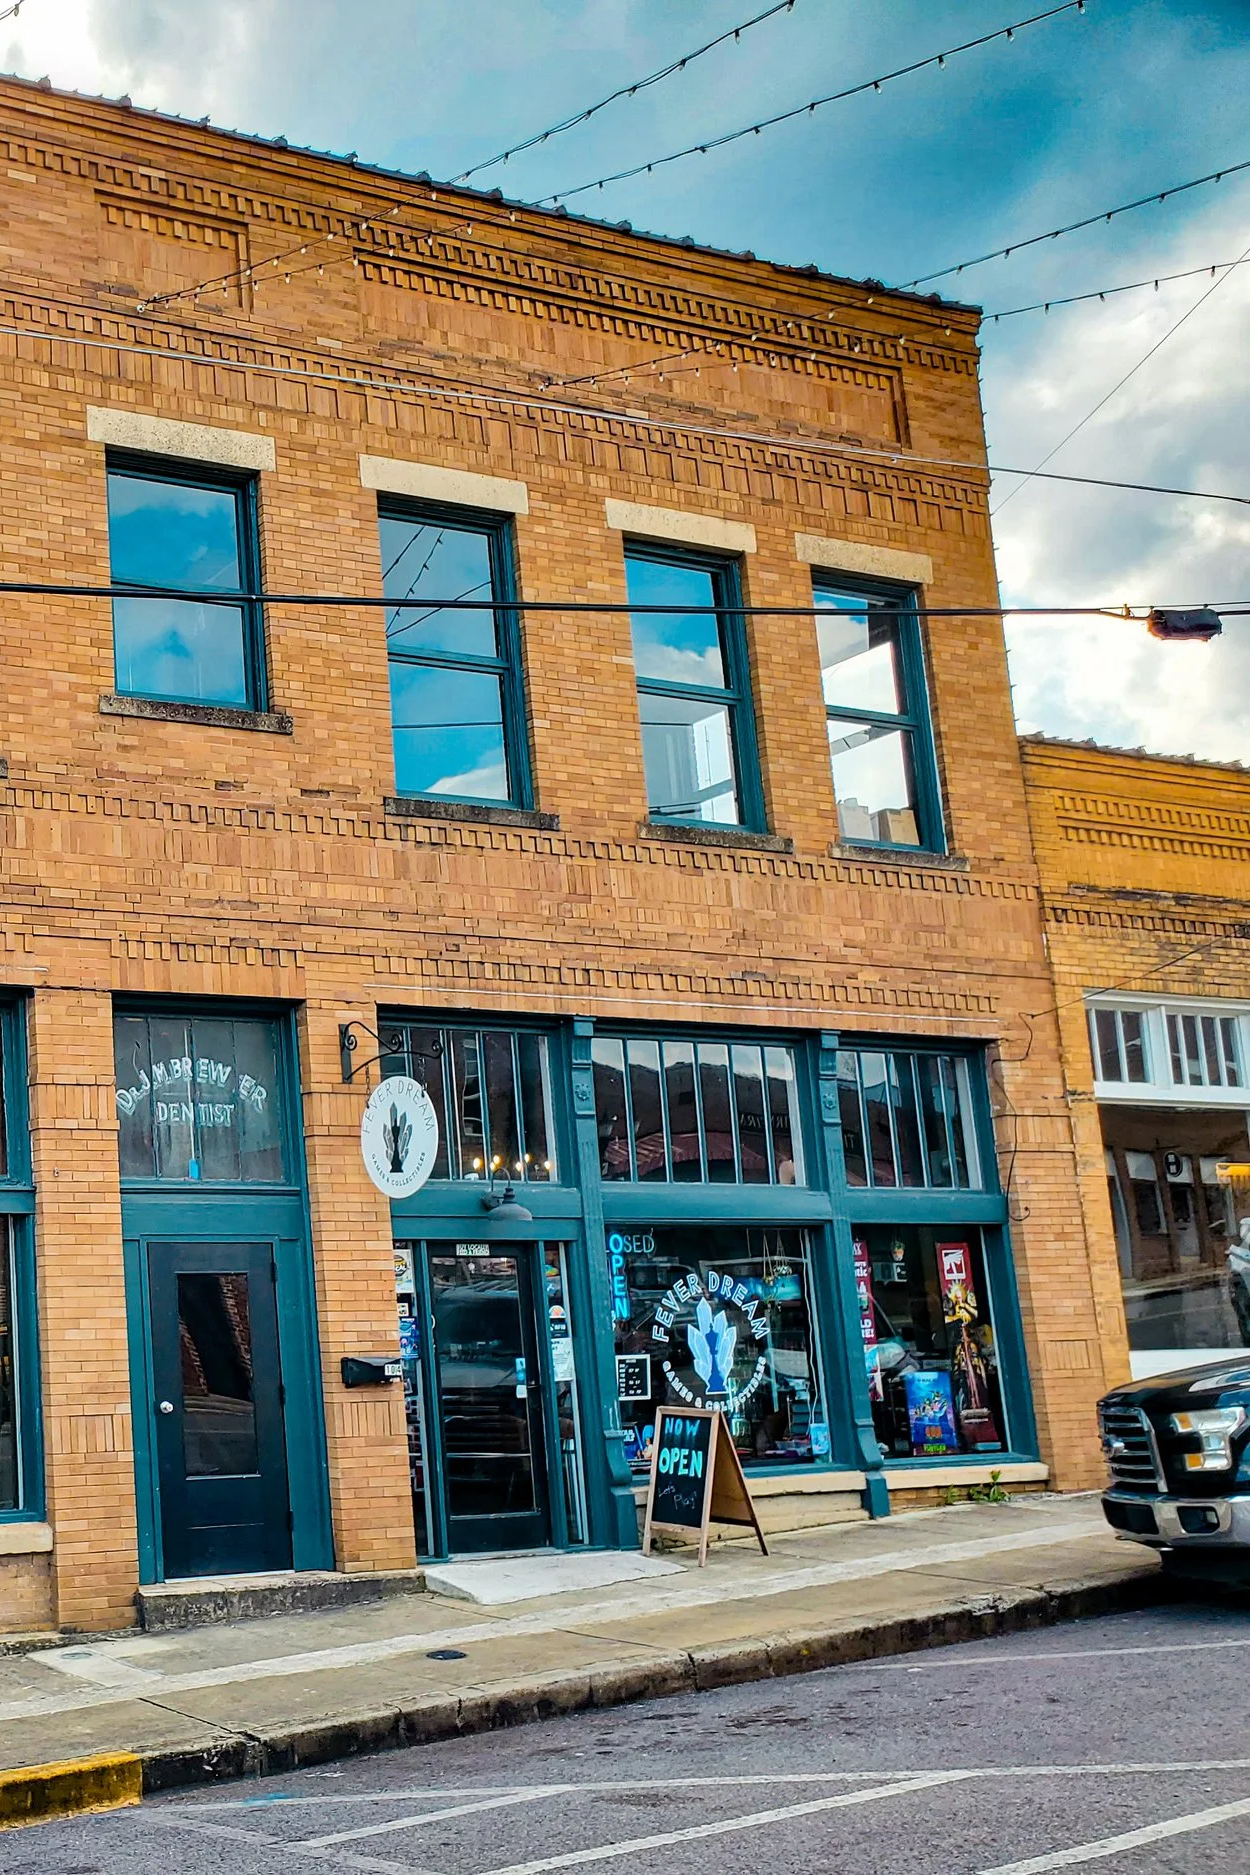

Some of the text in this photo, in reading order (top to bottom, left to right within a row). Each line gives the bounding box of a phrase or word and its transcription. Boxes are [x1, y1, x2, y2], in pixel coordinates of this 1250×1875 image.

[169, 1056, 268, 1114] BREWER
[362, 1079, 435, 1134] FEVER DREAM
[155, 1101, 236, 1127] DENTIST
[371, 1153, 386, 1179] GAMES
[391, 1152, 426, 1187] COLLECTIBLES
[608, 1233, 630, 1319] OPEN
[652, 1271, 770, 1343] FEVER DREAM
[662, 1361, 694, 1403] GAMES
[705, 1356, 767, 1412] COLLECTIBLES
[664, 1417, 700, 1436] NOW
[658, 1447, 703, 1478] OPEN
